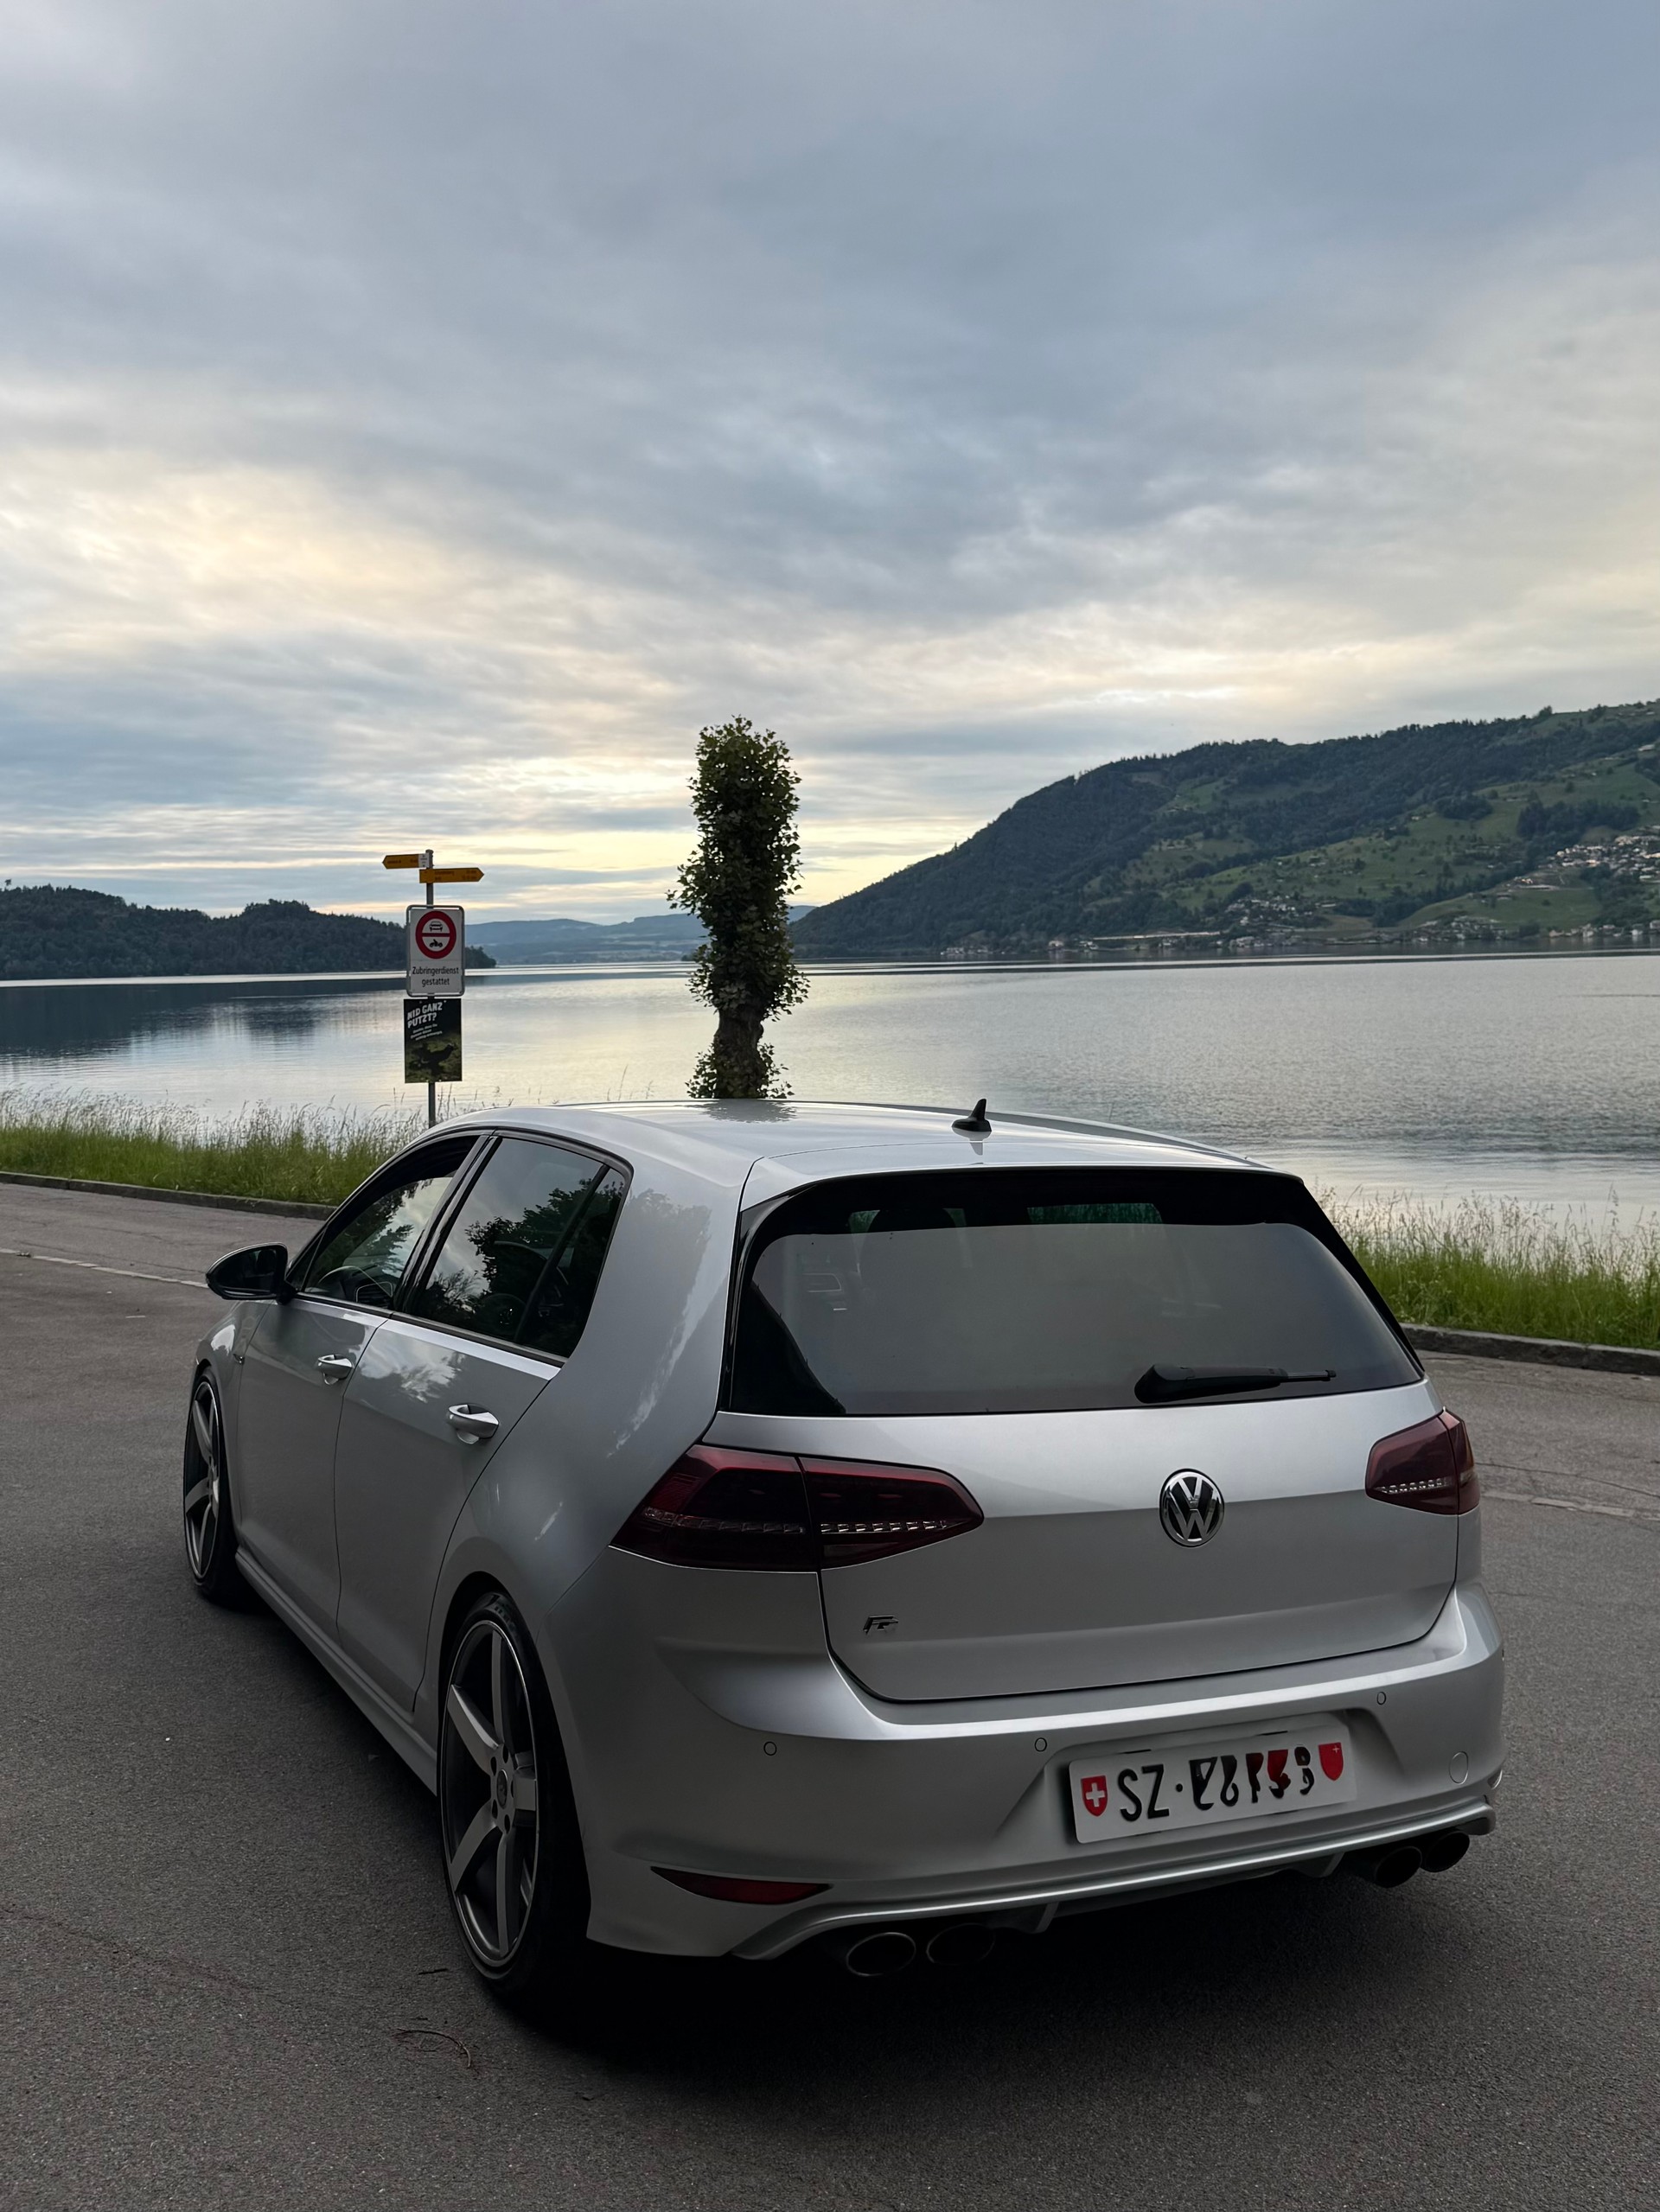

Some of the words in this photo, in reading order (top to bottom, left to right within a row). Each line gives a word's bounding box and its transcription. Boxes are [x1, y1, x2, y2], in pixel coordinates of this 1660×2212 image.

[412, 966, 459, 977] Zubringerdienst
[421, 978, 450, 988] gestattet
[422, 1002, 443, 1014] GANZ
[407, 1012, 437, 1029] PUTZT?
[1163, 1472, 1220, 1544] VW
